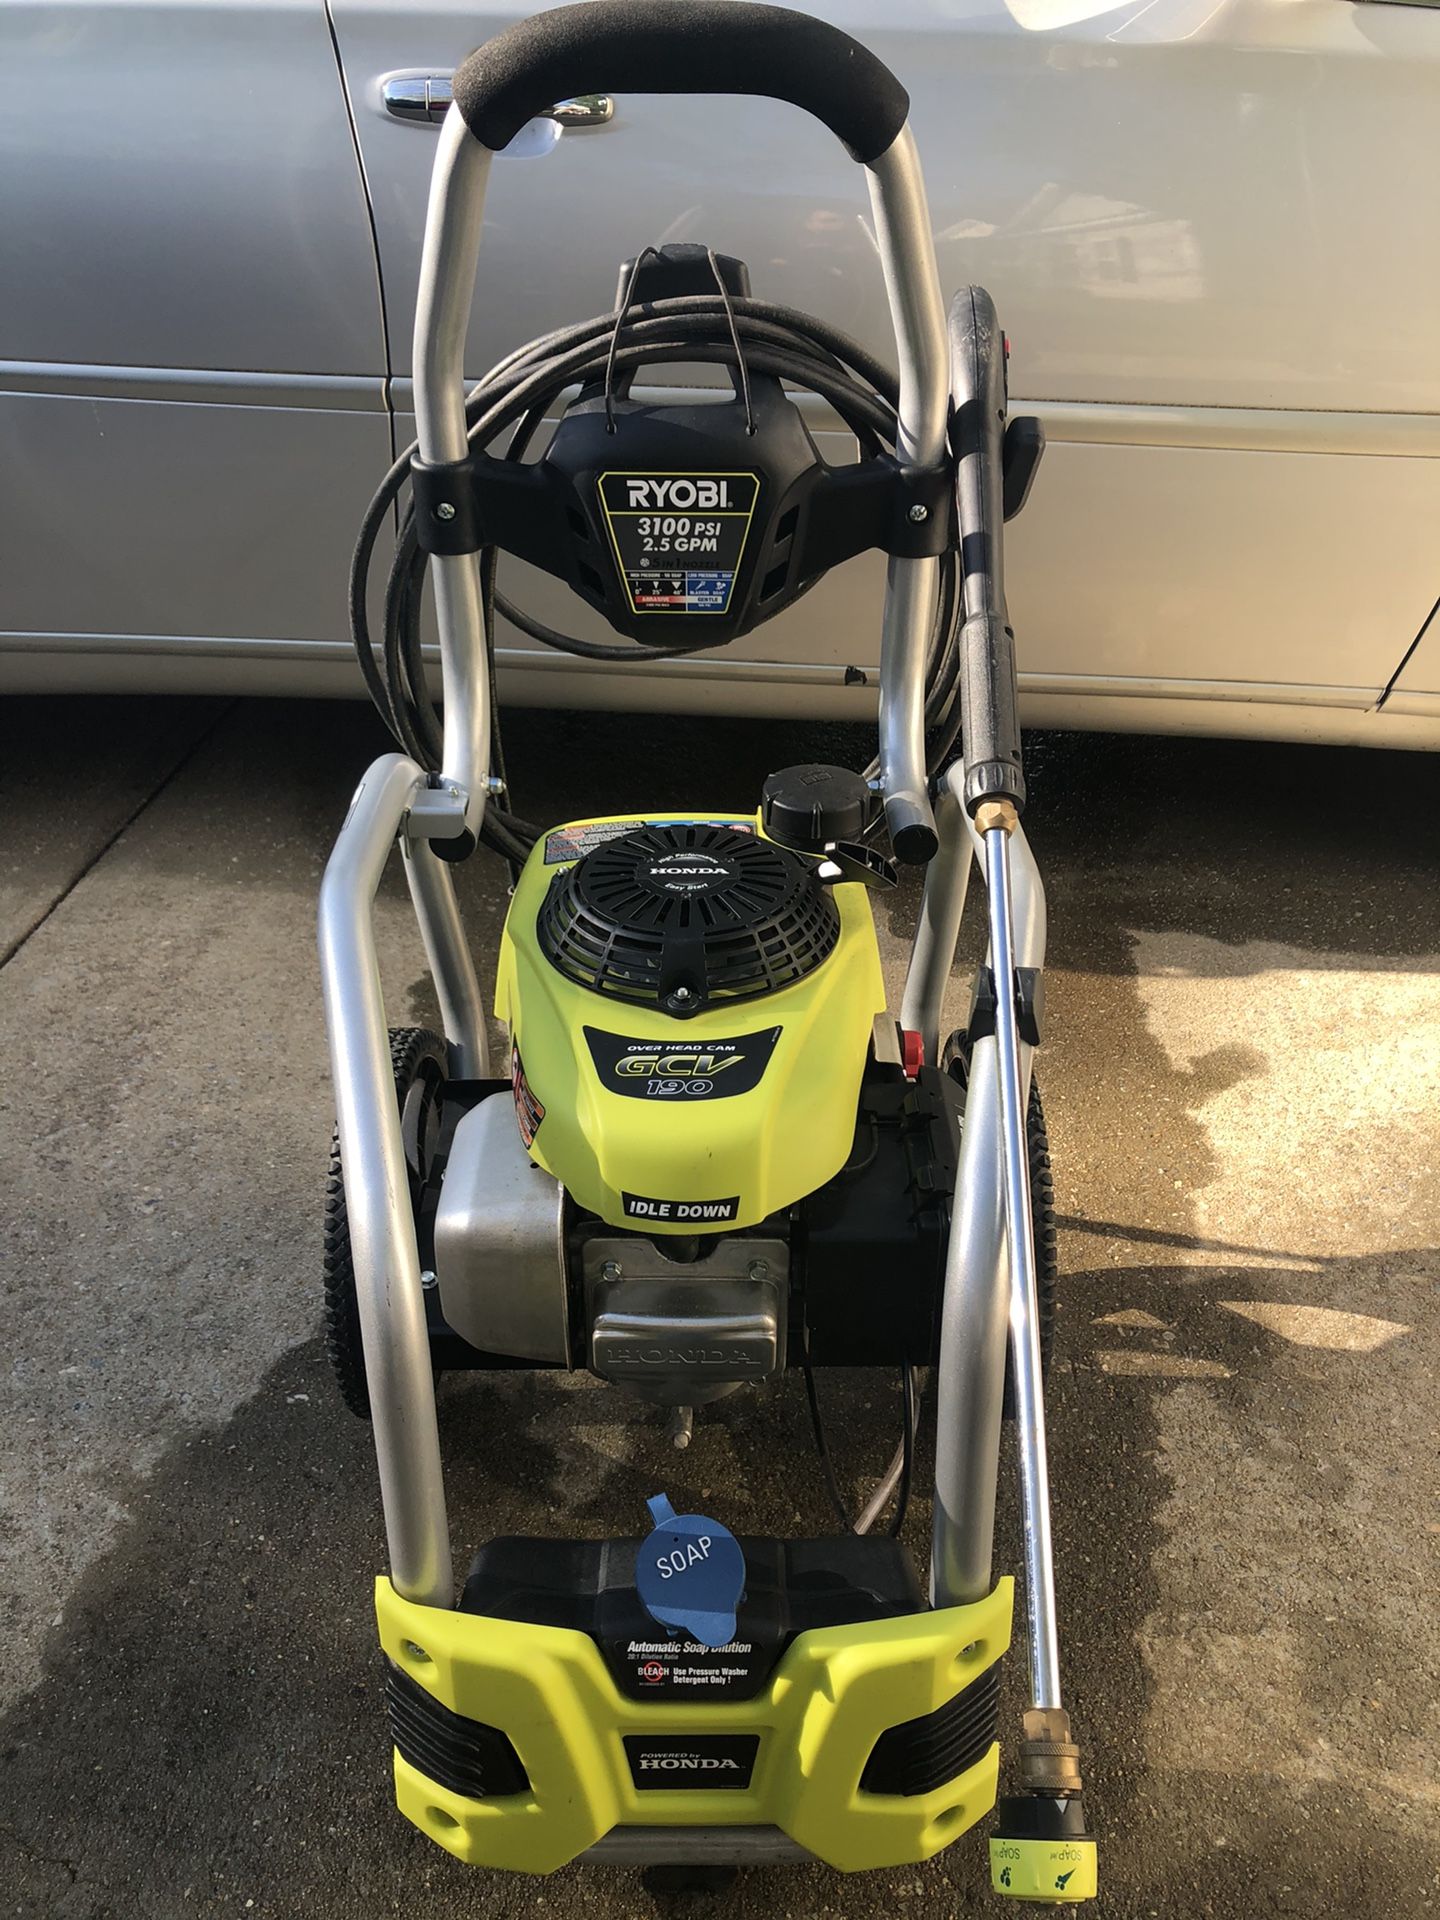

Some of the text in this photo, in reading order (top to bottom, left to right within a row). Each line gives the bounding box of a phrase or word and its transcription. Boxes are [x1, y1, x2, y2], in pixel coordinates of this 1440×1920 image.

[626, 479, 728, 508] RYOBI
[637, 517, 722, 536] 3100 PSI
[643, 538, 718, 552] 2.5 GPM
[664, 882, 686, 891] Easy
[615, 1055, 746, 1076] GCV
[647, 1079, 713, 1095] 190
[629, 1201, 731, 1218] IDLE DOWN
[607, 1348, 761, 1365] HONDA
[656, 1536, 712, 1579] SOAP
[627, 1641, 681, 1653] Automatic
[683, 1641, 709, 1655] Soap
[638, 1668, 670, 1676] BLEACH
[673, 1676, 709, 1685] Detergent
[639, 1759, 740, 1769] HONDA
